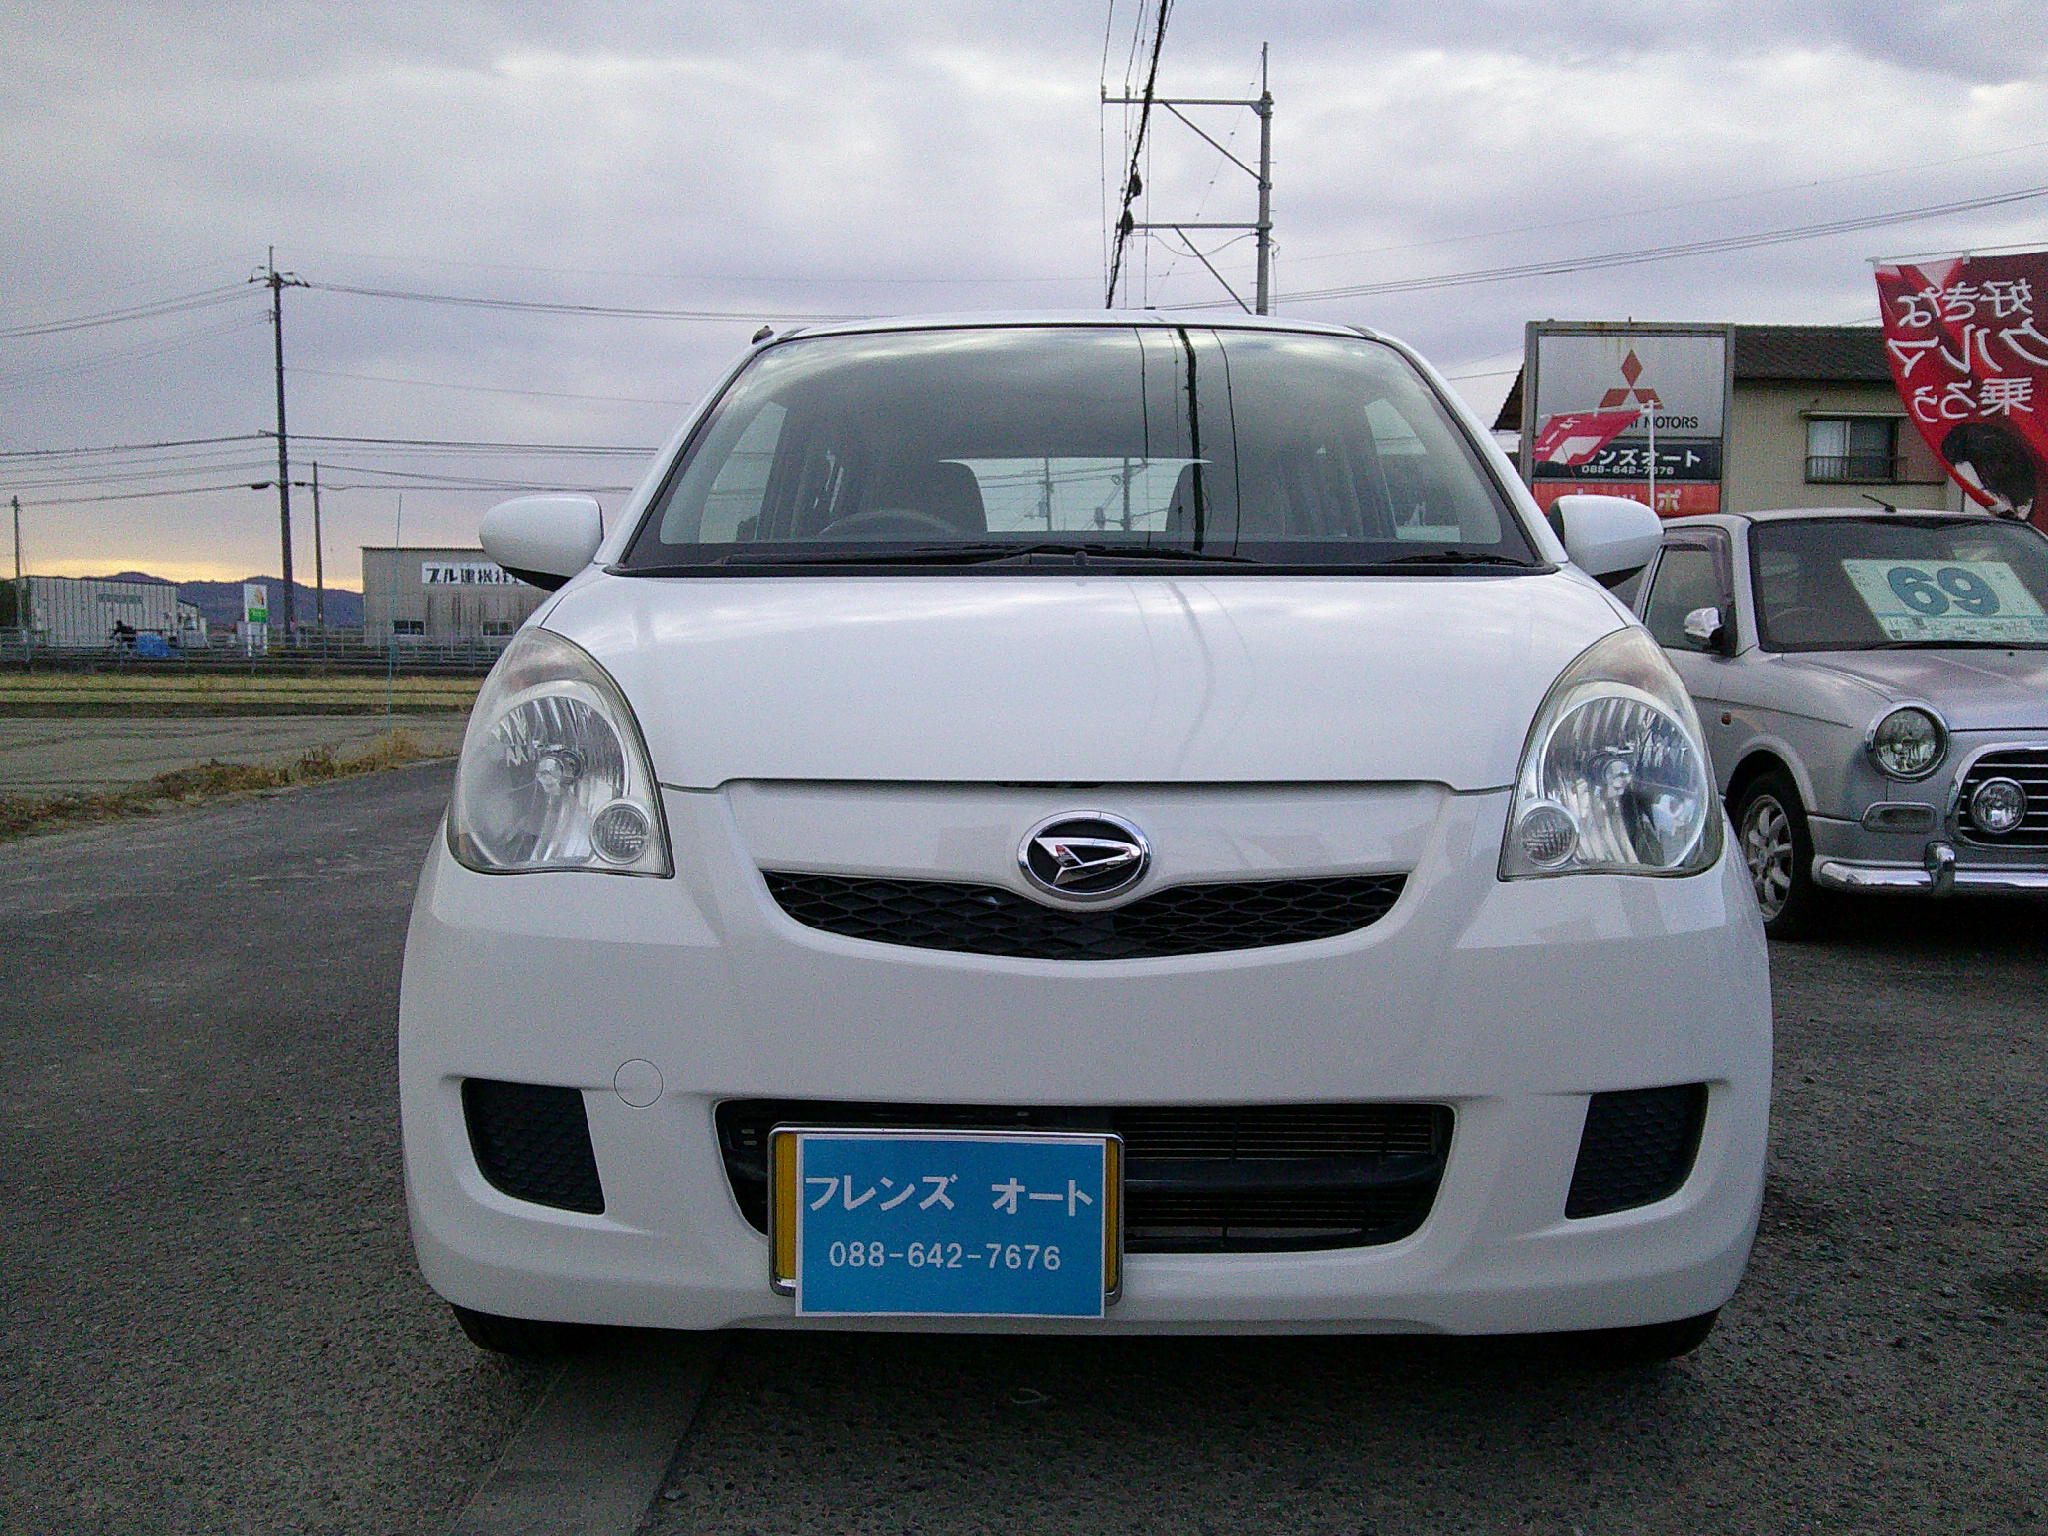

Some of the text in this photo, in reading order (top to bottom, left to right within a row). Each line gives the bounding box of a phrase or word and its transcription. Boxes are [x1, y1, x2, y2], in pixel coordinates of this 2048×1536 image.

[1644, 416, 1699, 429] MOTORS
[1597, 448, 1701, 468] ンズオート
[1887, 566, 2001, 616] 69
[804, 1172, 1094, 1217] フレンズ オート
[829, 1241, 1062, 1271] 088-642-7676
